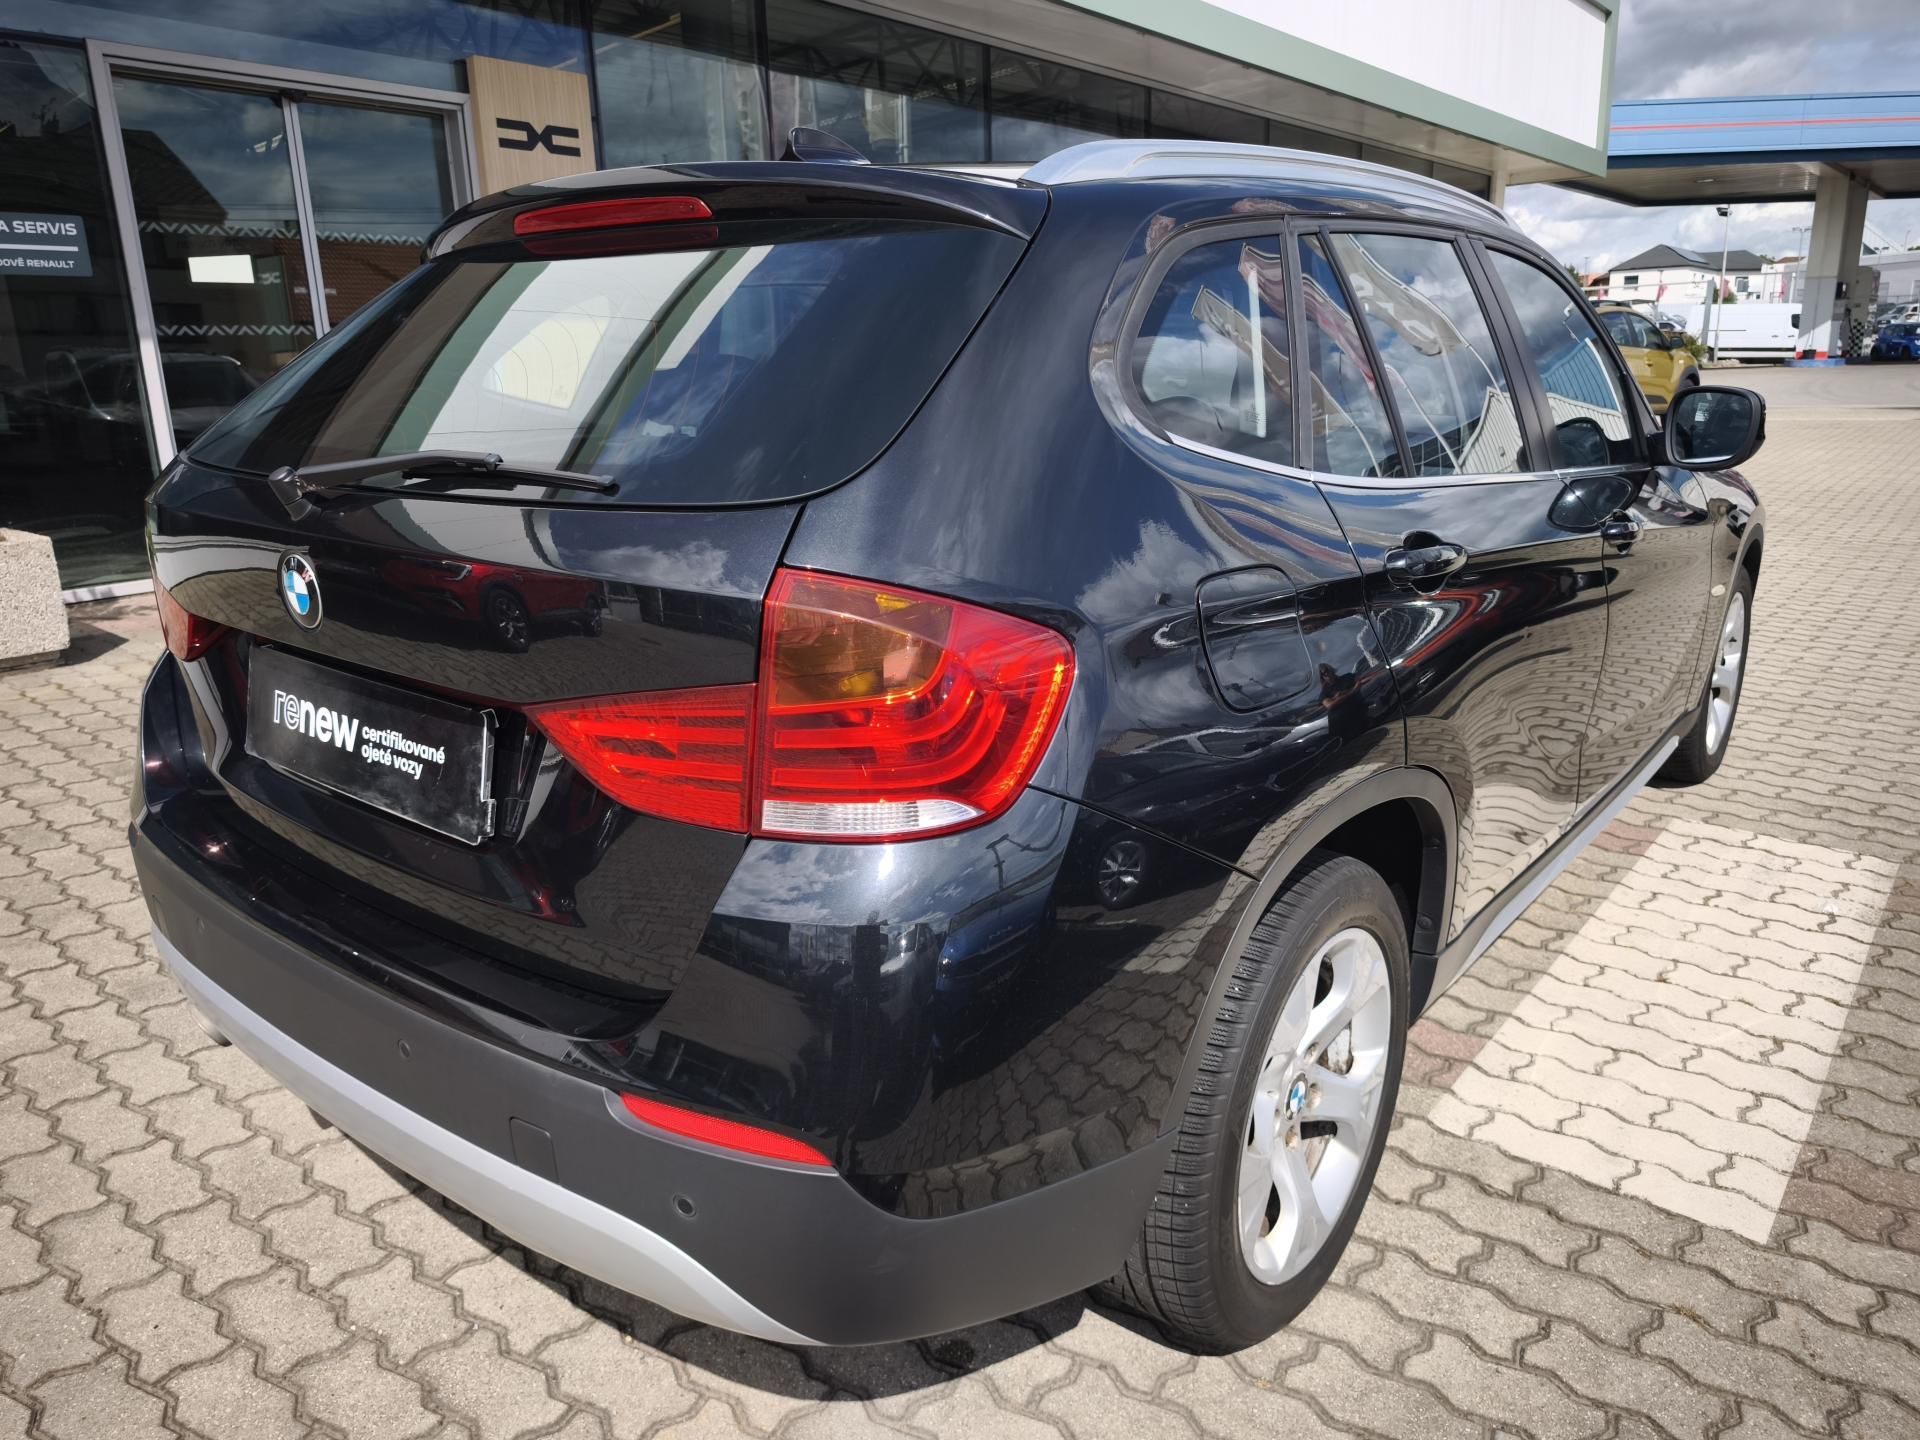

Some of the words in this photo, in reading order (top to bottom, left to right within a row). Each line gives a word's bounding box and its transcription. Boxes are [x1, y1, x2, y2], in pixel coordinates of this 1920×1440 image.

[12, 220, 77, 236] SERVIS
[26, 258, 75, 269] RENAULT
[273, 689, 359, 752] renew
[361, 725, 445, 765] certifikované
[361, 742, 392, 766] ojeté
[393, 755, 423, 780] vozy
